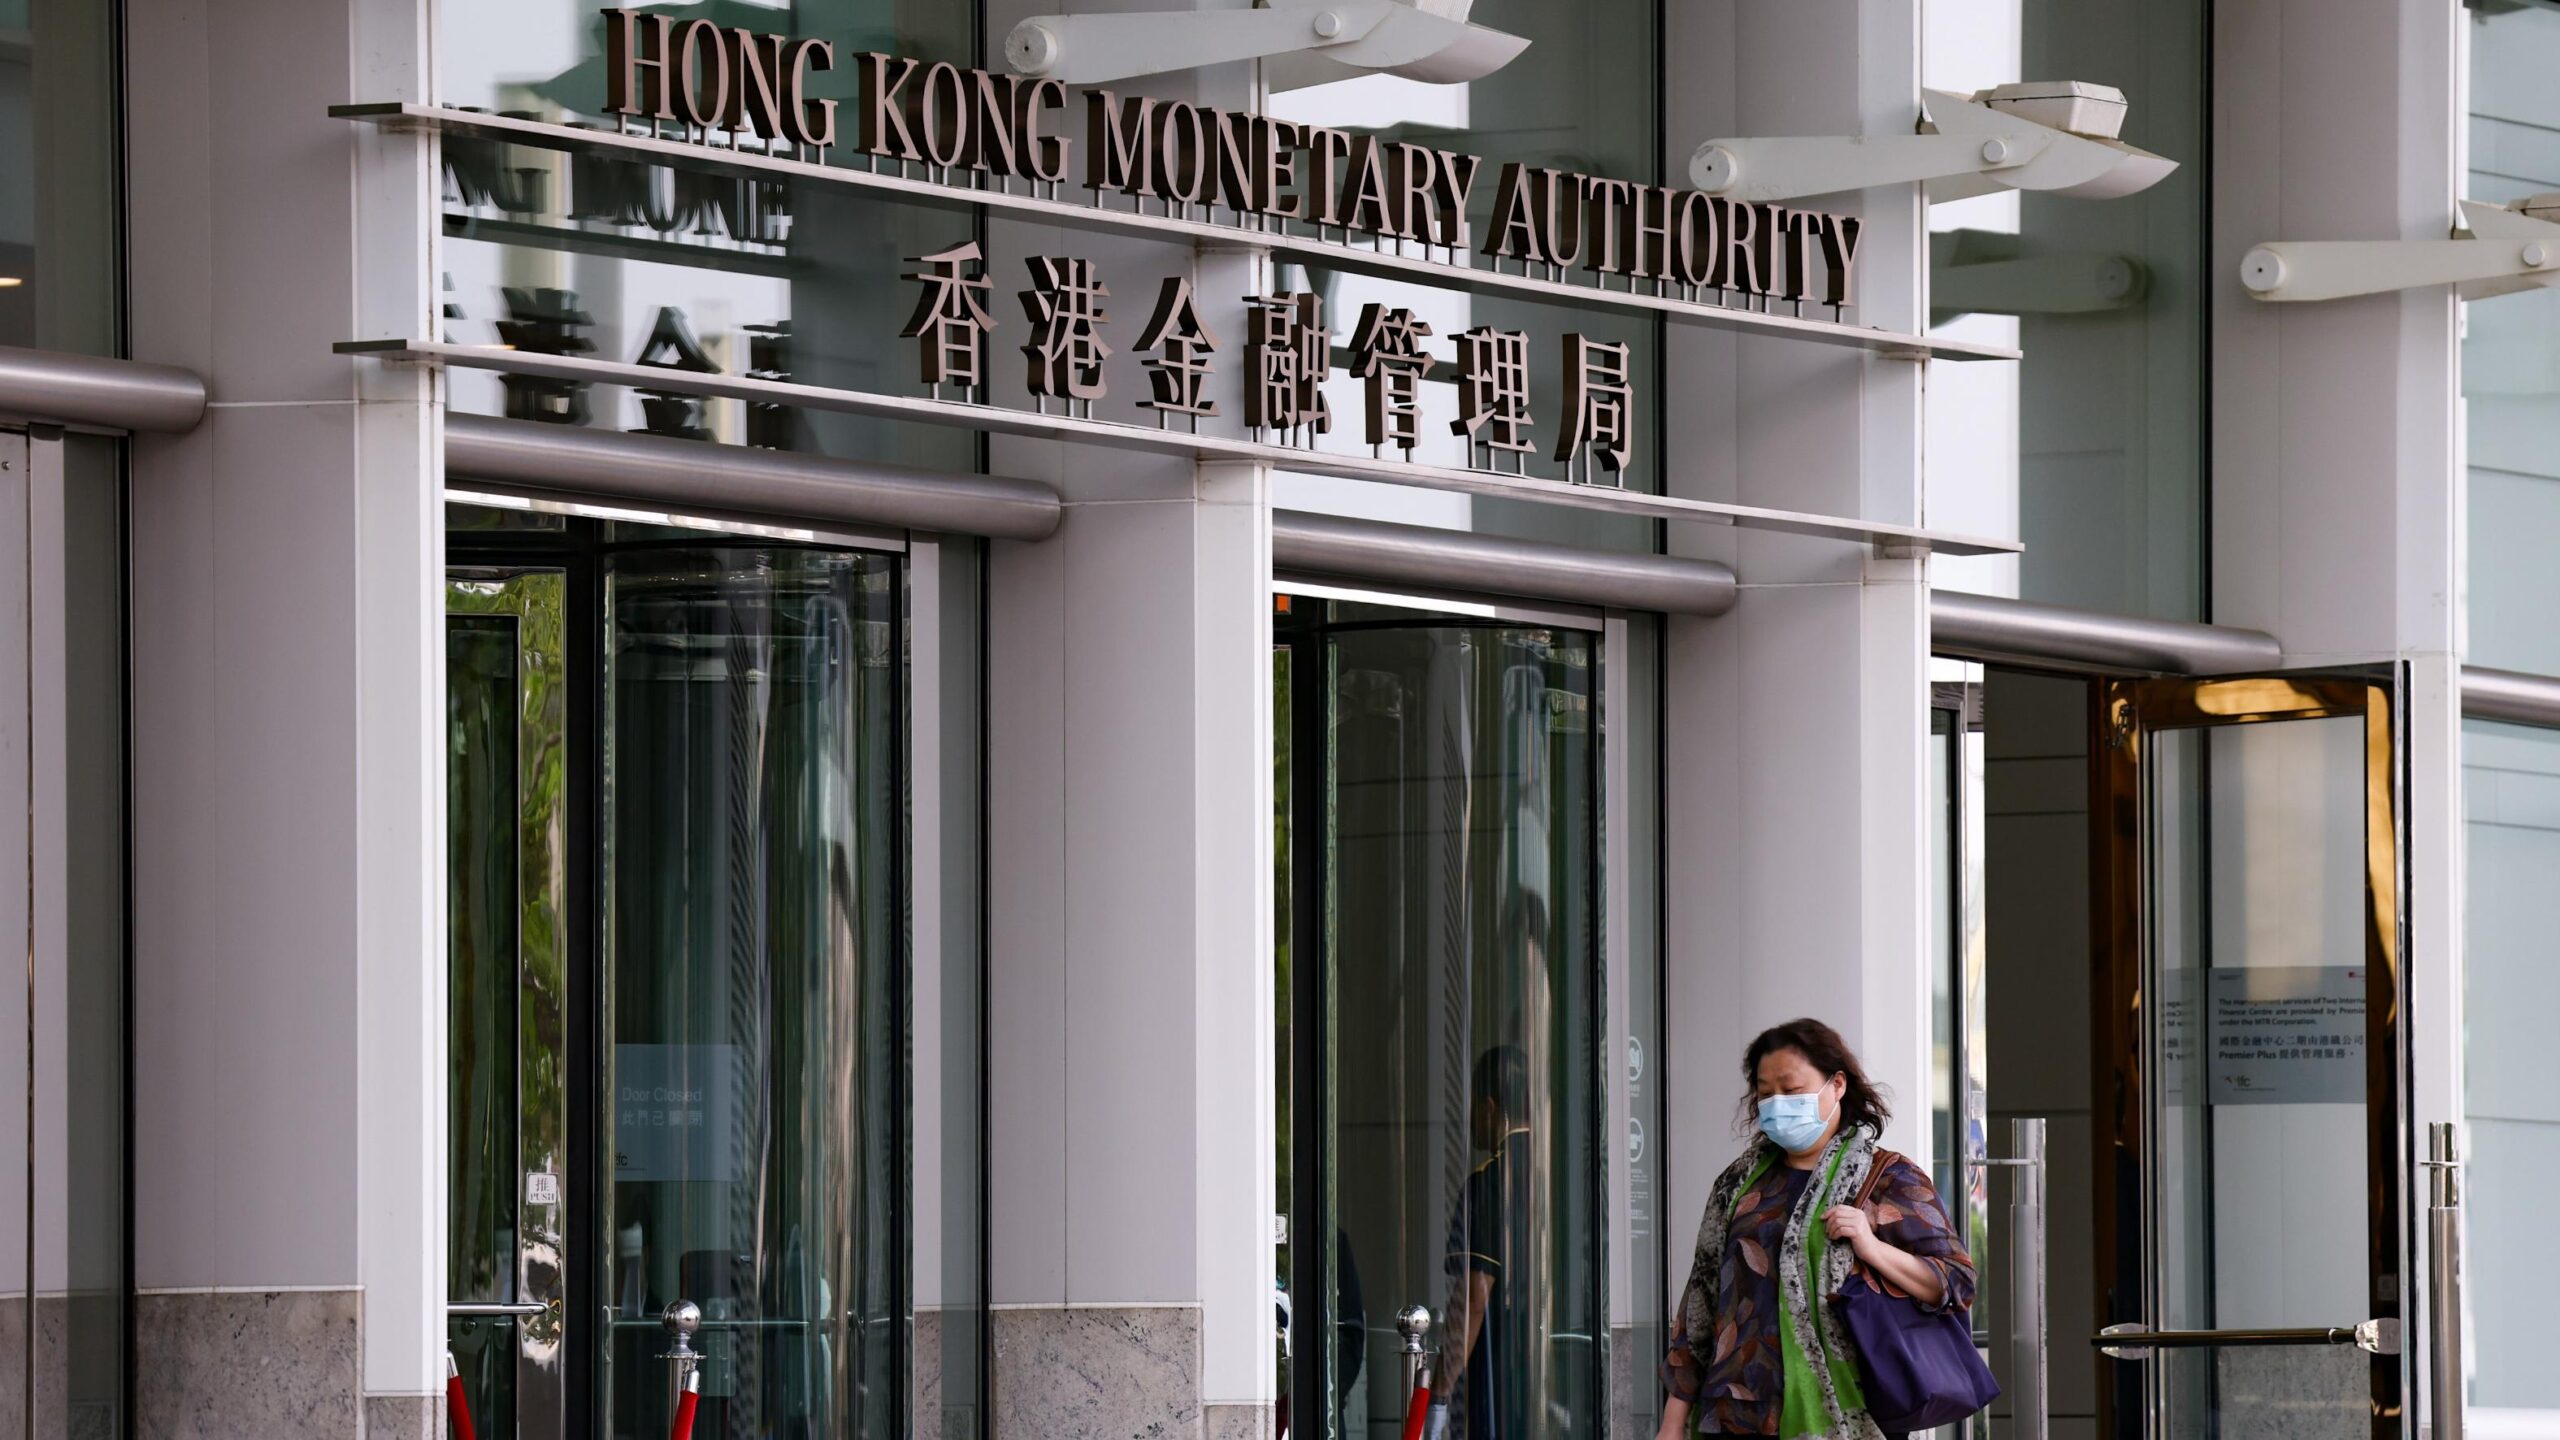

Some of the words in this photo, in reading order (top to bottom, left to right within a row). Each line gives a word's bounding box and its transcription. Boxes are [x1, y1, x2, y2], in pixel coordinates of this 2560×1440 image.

[601, 7, 838, 148] HONG
[853, 51, 1072, 184] KONG
[1082, 89, 1483, 248] MONETARY
[1482, 162, 1866, 307] AUTHORITY
[900, 240, 1634, 473] 香港金融管理局
[2290, 1008, 2323, 1016] provided
[2218, 1050, 2254, 1059] Premier
[2256, 1050, 2277, 1059] Plus
[622, 1087, 649, 1102] Door
[654, 1087, 702, 1102] Closed
[530, 1193, 555, 1201] PUSH
